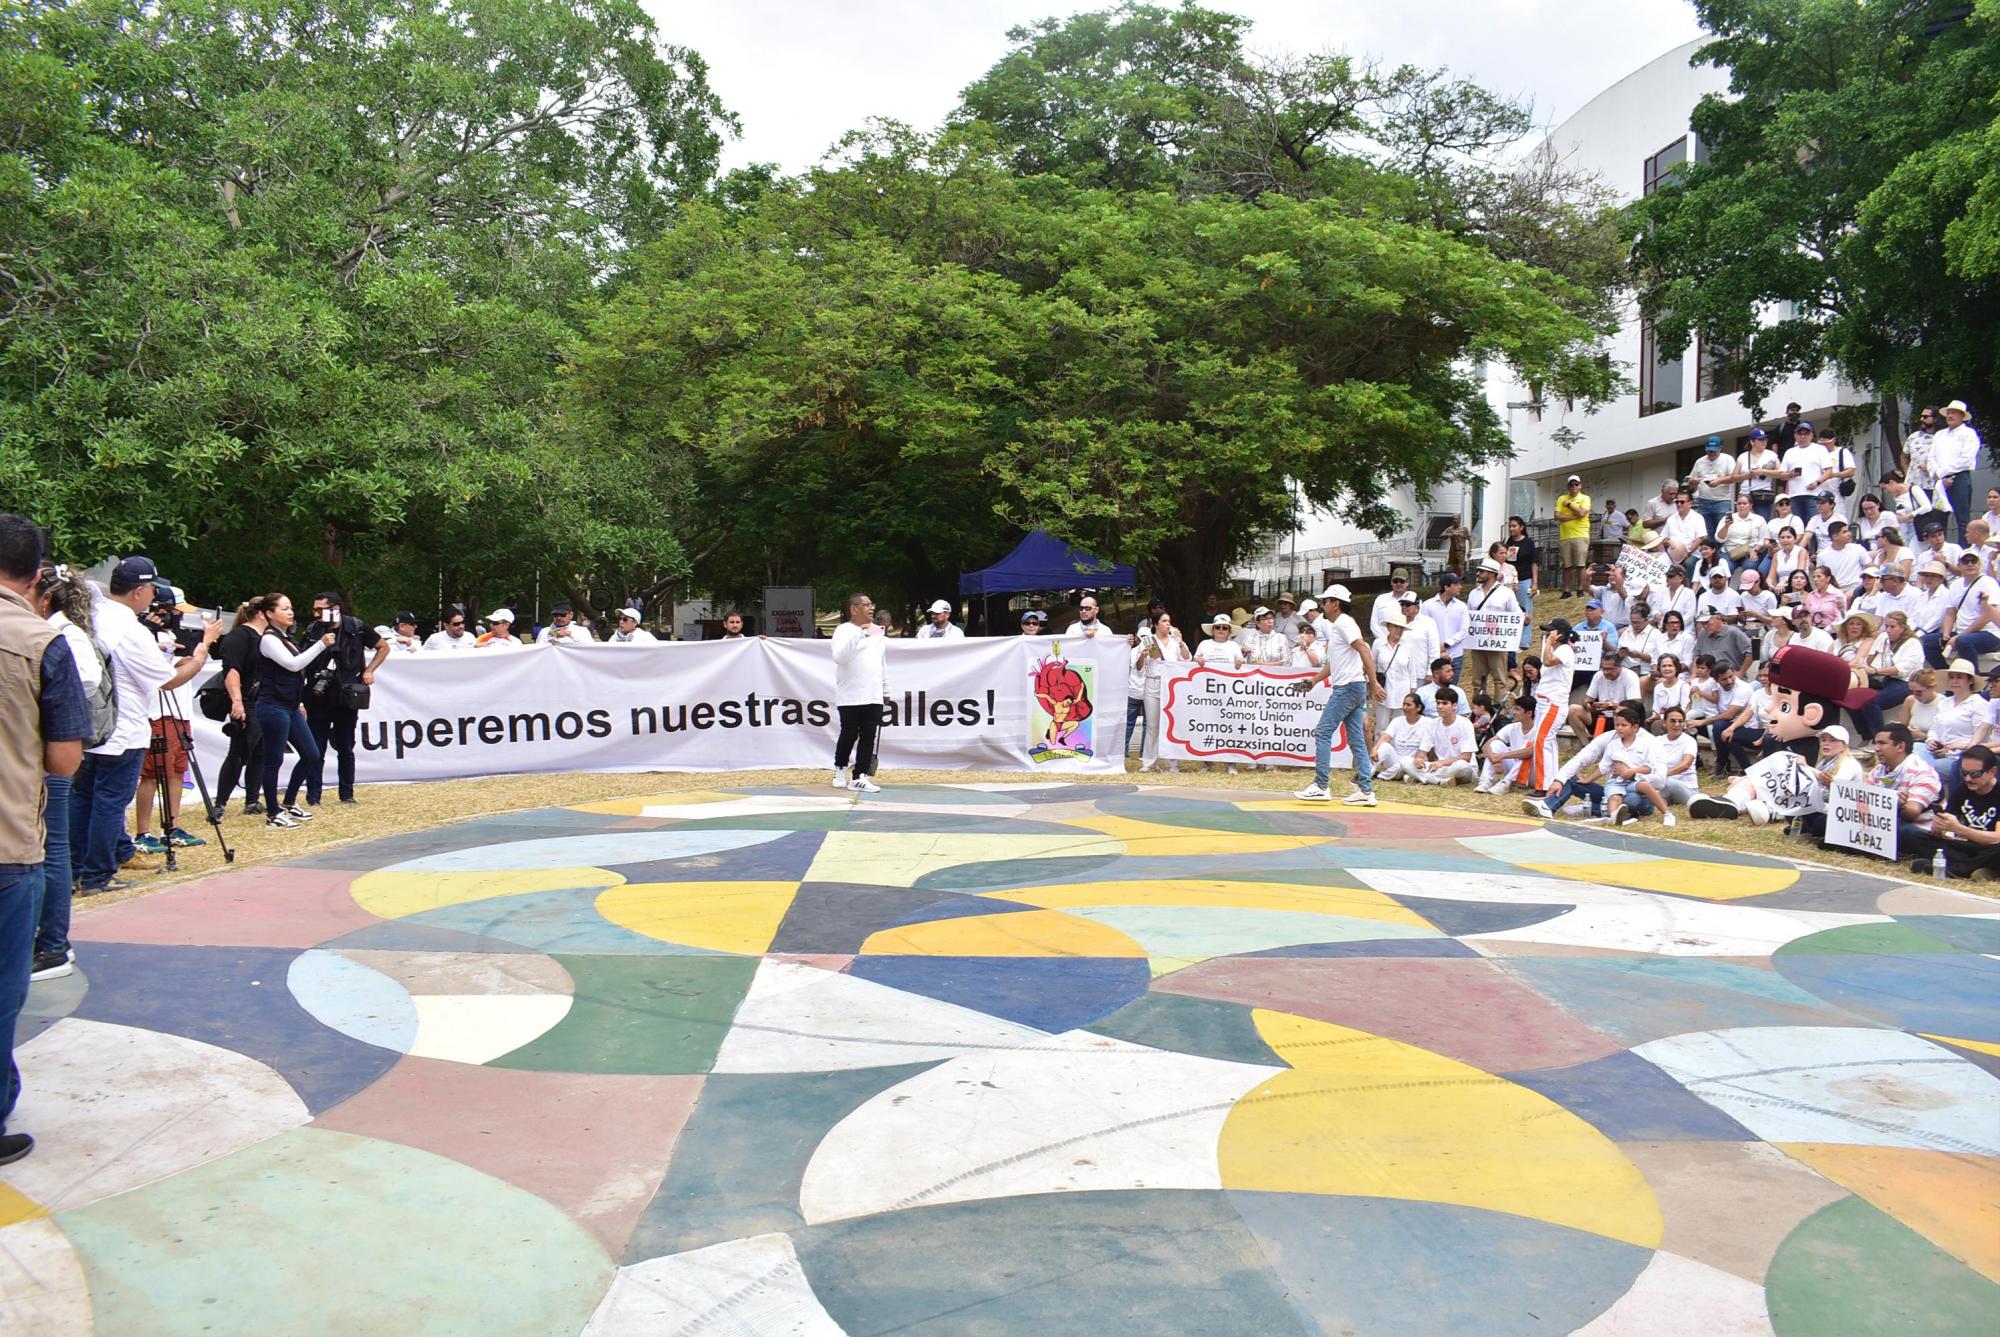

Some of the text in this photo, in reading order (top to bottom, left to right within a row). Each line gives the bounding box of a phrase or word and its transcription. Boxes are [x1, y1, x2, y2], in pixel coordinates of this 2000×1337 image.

[1469, 614, 1521, 624] VALIENTE ES
[1468, 626, 1518, 637] QUIEN ELIGE
[1583, 634, 1601, 643] UNA
[1478, 639, 1508, 649] LA PAZ
[1206, 678, 1227, 694] En
[1187, 694, 1223, 707] Somos
[1226, 696, 1262, 710] Amor,
[1266, 699, 1302, 711] Somos
[1220, 708, 1294, 722] Somos Unión
[361, 689, 996, 760] uperemos nuestras alles!
[1189, 719, 1233, 734] Somos
[1252, 722, 1269, 736] los
[1203, 735, 1307, 752] #pazxsinaloa
[1837, 785, 1893, 811] VALIENTE ES
[1835, 806, 1892, 832] QUIEN ELIGE
[1849, 829, 1883, 851] LA PAZ
